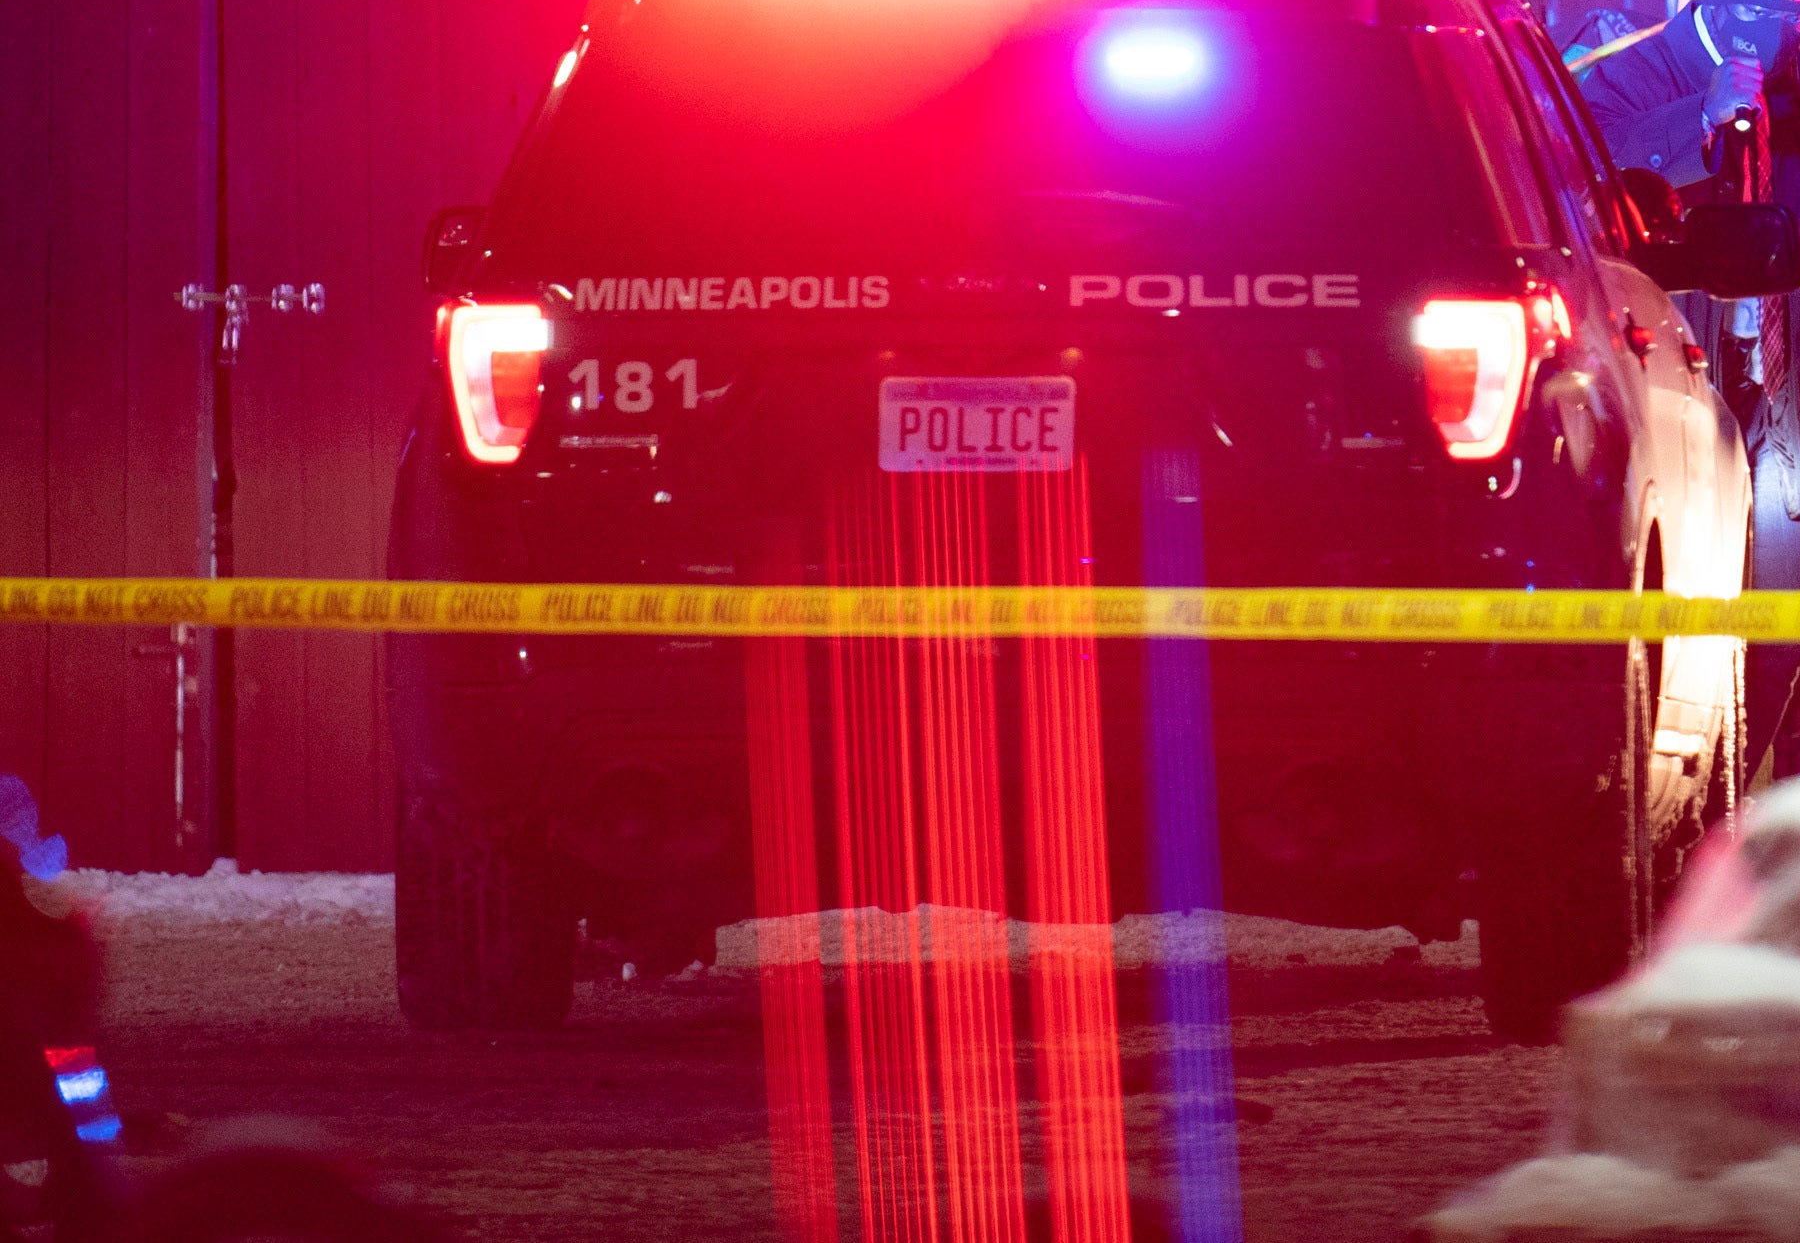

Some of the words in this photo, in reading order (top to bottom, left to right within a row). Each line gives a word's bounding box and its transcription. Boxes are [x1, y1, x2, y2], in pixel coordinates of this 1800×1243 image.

[575, 275, 891, 312] MINNEAPOLIS
[1069, 274, 1361, 307] POLICE
[568, 358, 700, 414] 181
[899, 406, 1060, 453] POLICE
